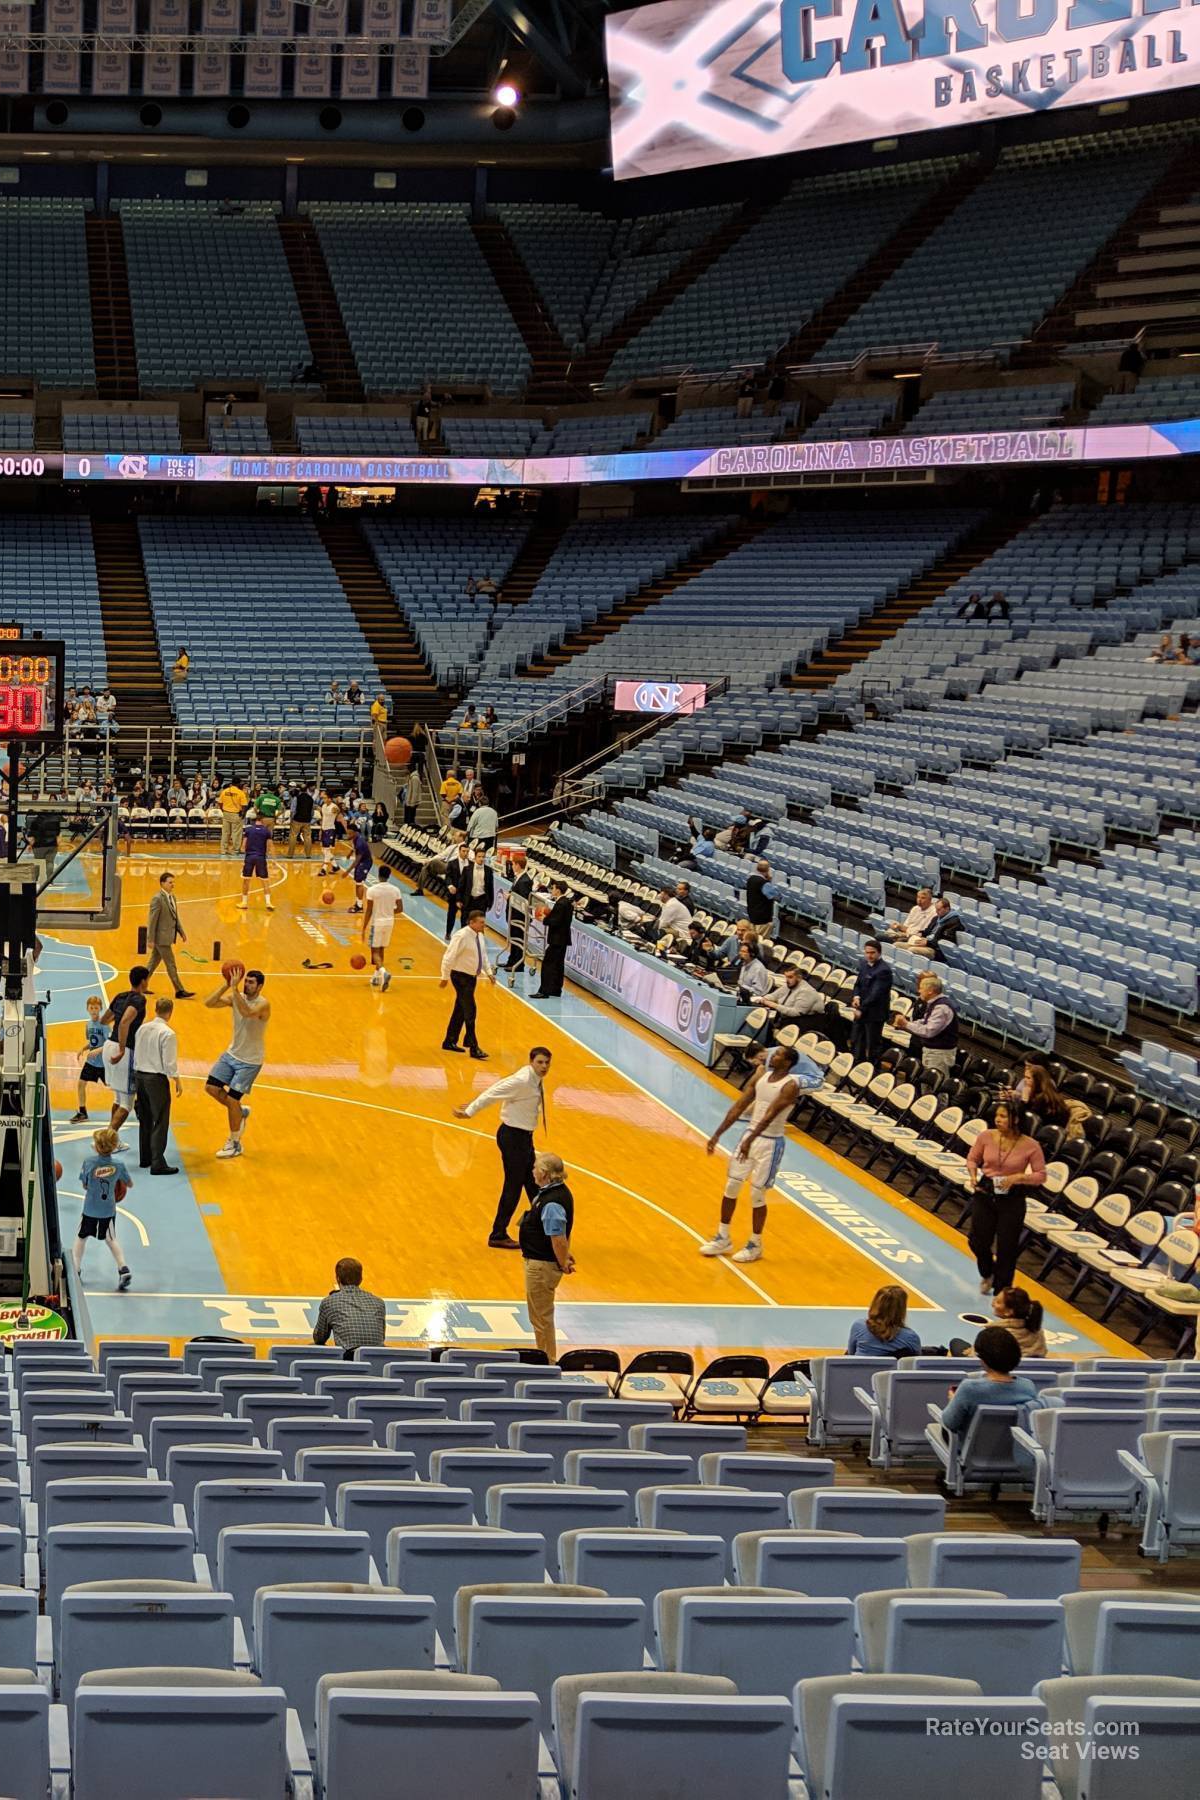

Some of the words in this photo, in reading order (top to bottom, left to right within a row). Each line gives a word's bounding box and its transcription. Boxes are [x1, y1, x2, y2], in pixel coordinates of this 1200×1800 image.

[934, 30, 1188, 108] BASKETBALL
[716, 440, 855, 474] CAROLINA
[868, 431, 1074, 467] BASKETBALL
[78, 458, 90, 476] 0
[167, 459, 186, 468] TOL:
[188, 459, 194, 468] 4
[232, 461, 269, 476] HOME
[275, 461, 293, 476] OF
[296, 462, 361, 477] CAROLINA
[368, 462, 450, 479] BASKETBALL
[167, 468, 186, 478] FLS:
[188, 469, 194, 478] 0
[776, 1171, 924, 1264] @GOHEELS
